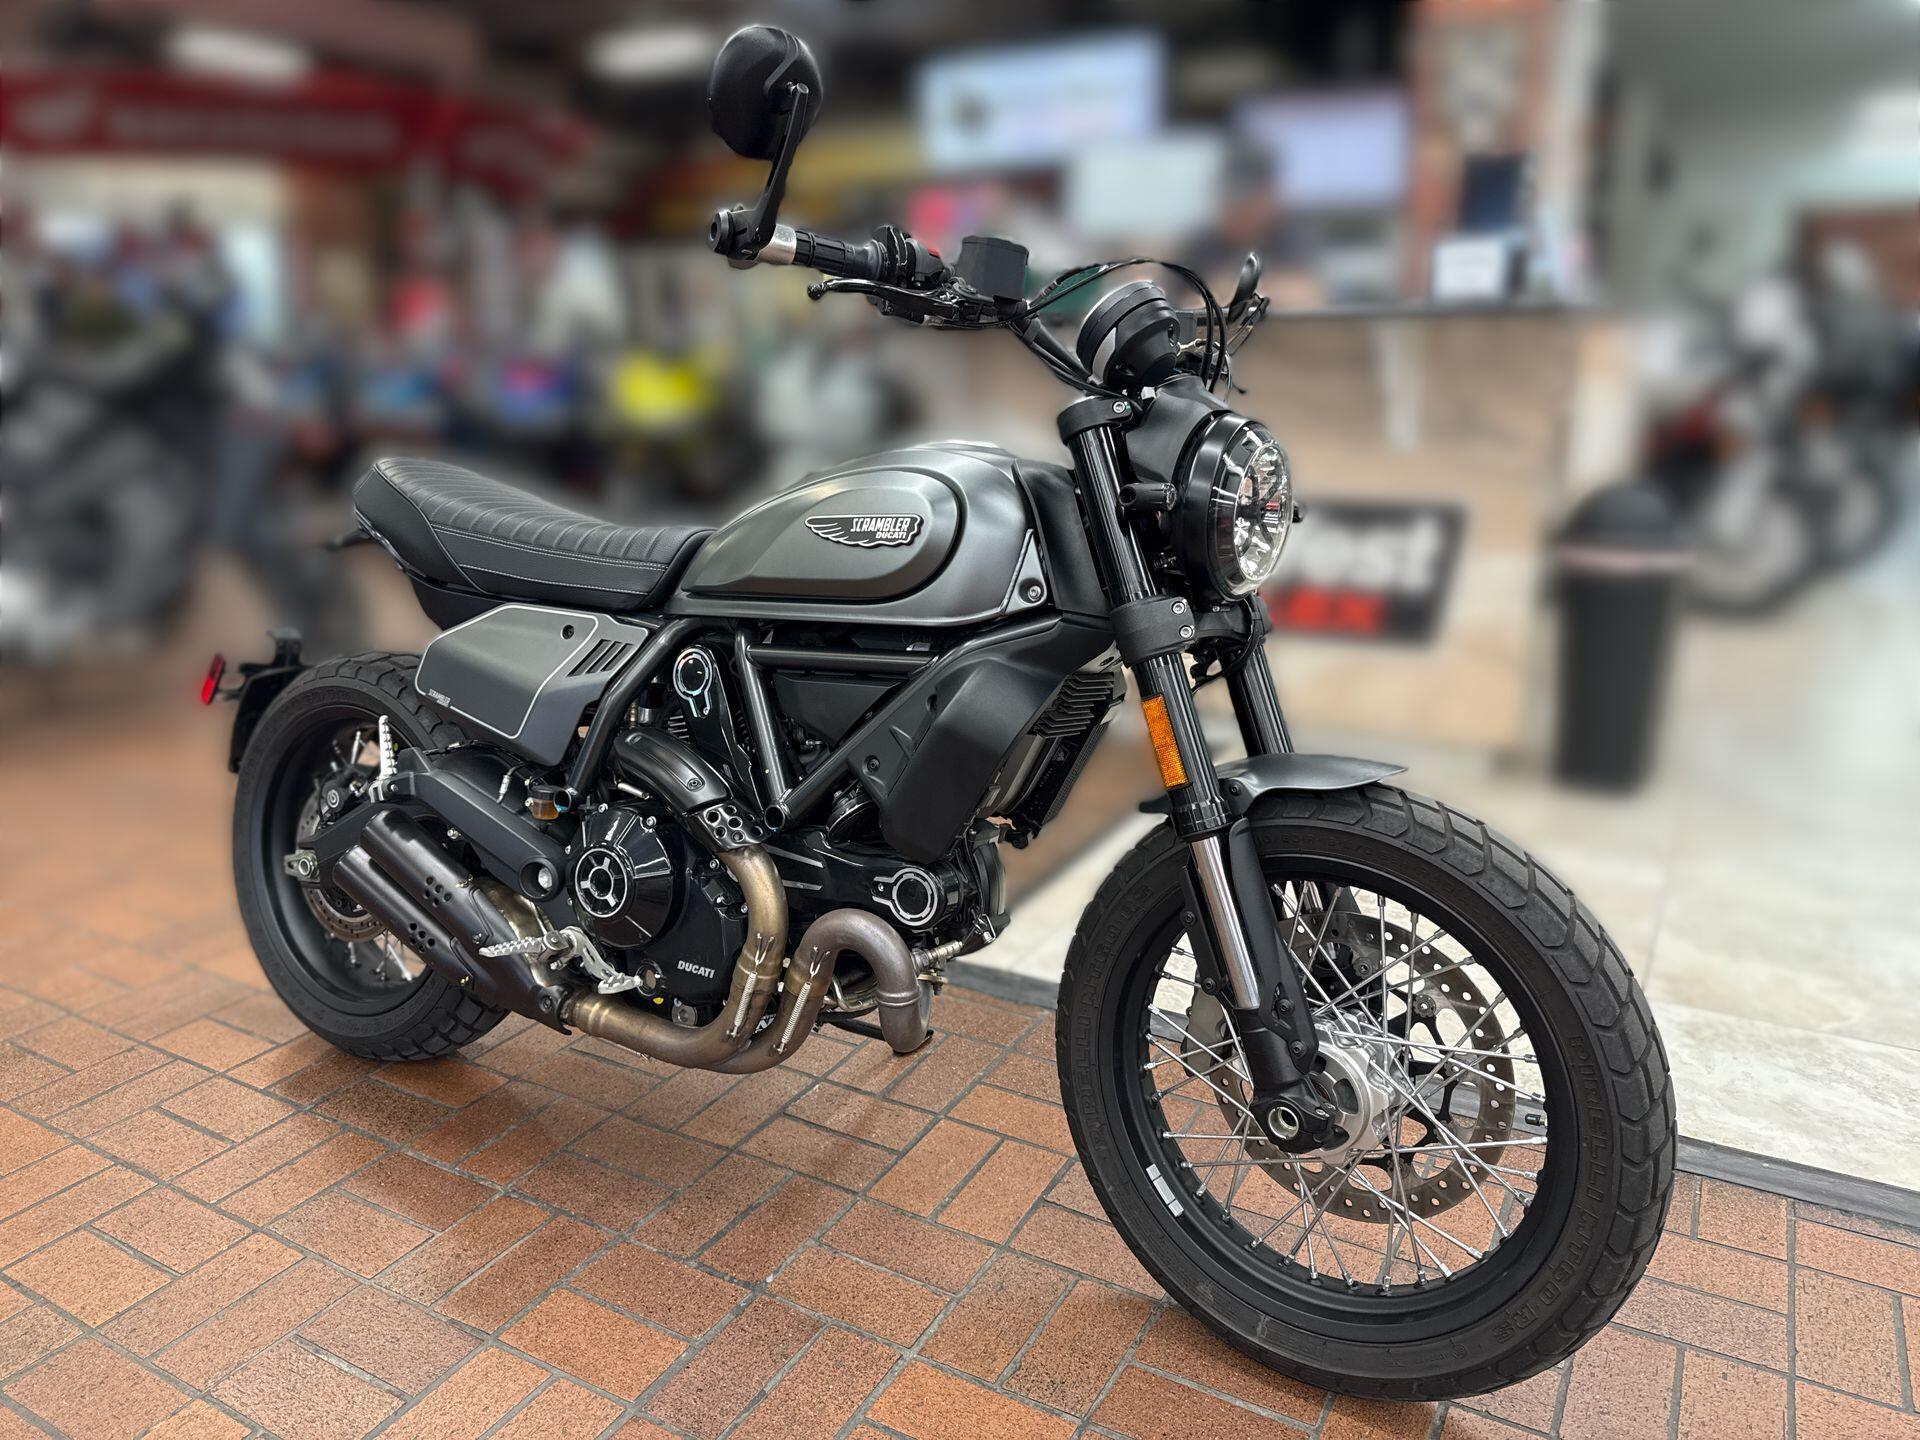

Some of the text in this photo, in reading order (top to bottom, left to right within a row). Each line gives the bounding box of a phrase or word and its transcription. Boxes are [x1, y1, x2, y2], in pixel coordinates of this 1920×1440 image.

[850, 517, 911, 532] SCRAMBLER
[875, 531, 907, 539] DUCATI
[676, 960, 716, 979] DUCATI
[1568, 1034, 1609, 1202] PIRELLI
